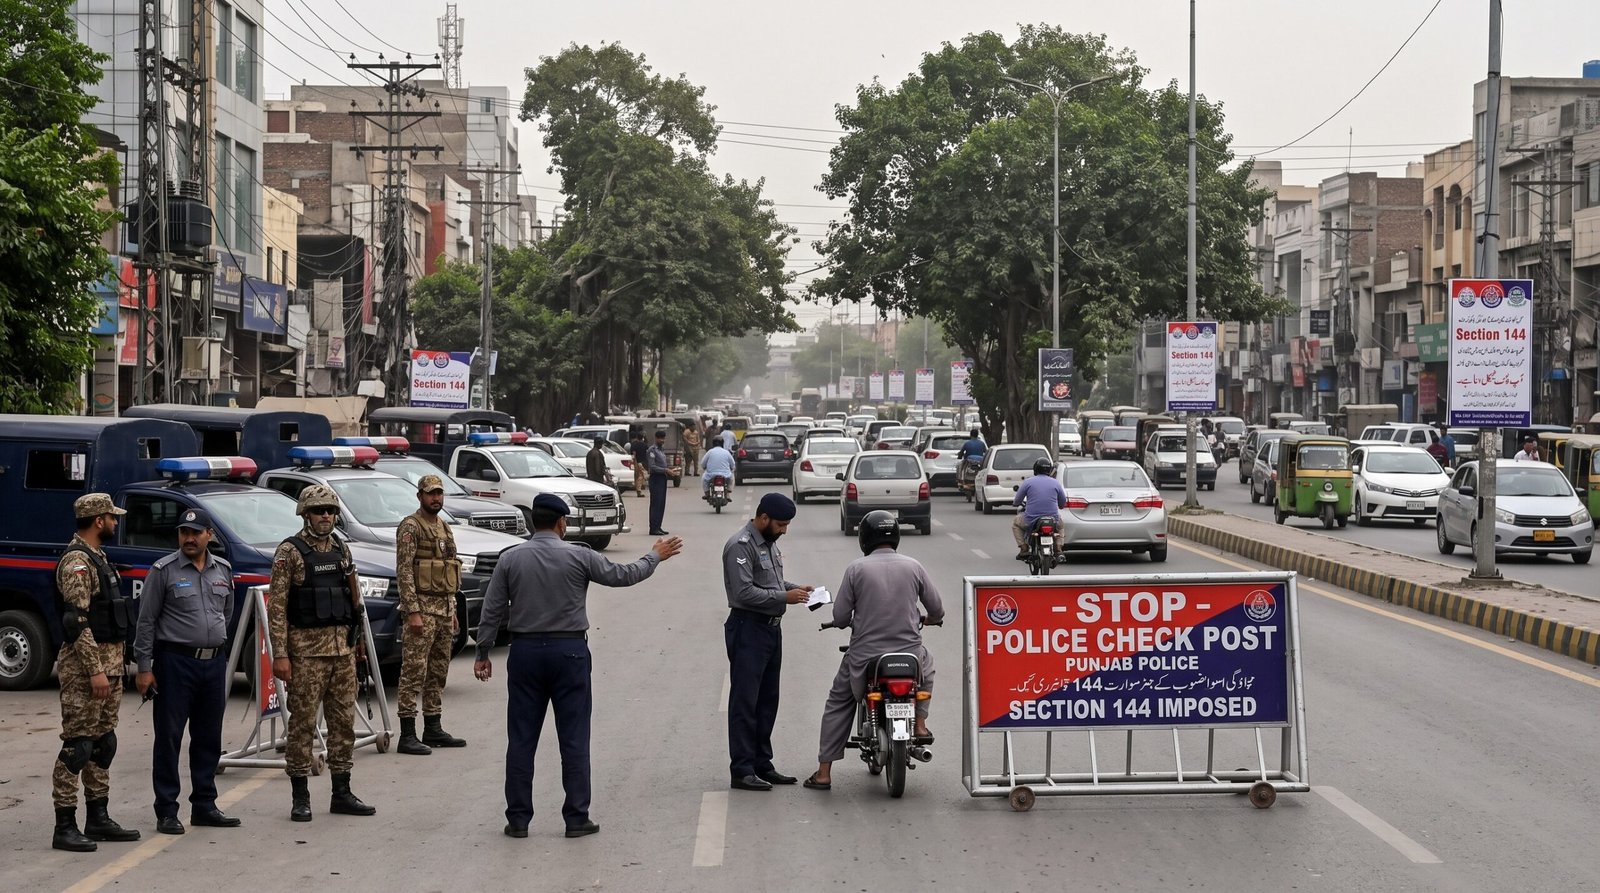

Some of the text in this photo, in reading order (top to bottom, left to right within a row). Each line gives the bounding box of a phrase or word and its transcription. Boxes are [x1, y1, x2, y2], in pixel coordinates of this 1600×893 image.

[1456, 328, 1526, 341] Section 144
[1171, 351, 1213, 359] Section 144
[414, 379, 465, 390] Section 144
[1076, 591, 1187, 623] STOP
[987, 625, 1277, 654] POLICE CHECK POST
[1065, 655, 1199, 672] PUNJAB POLICE
[1072, 676, 1103, 692] 144
[1009, 697, 1256, 720] SECTION 144 IMPOSED
